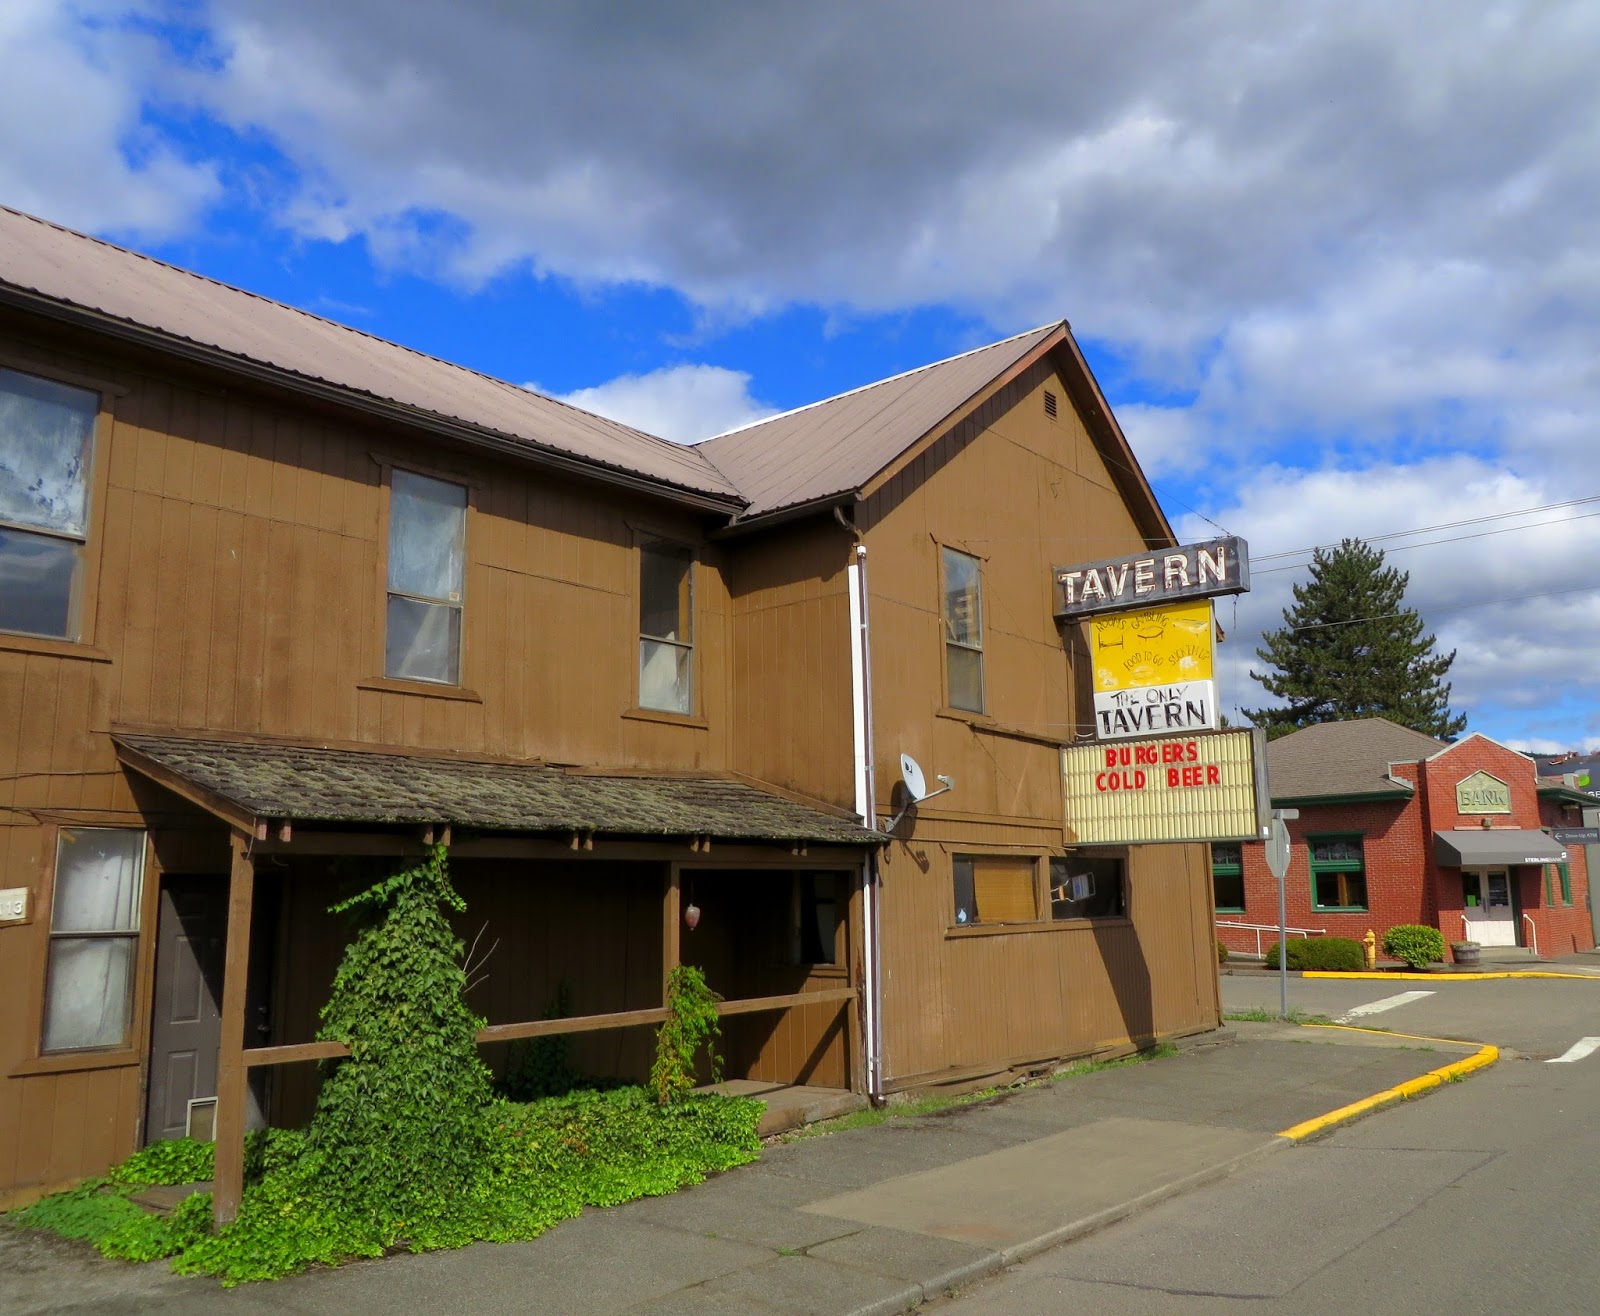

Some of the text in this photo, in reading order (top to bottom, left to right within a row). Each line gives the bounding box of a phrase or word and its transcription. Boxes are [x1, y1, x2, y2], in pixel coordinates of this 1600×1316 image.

[1058, 546, 1226, 604] TAVERN
[1095, 616, 1127, 632] ROOMS
[1131, 610, 1169, 630] GAMBLING
[1123, 650, 1164, 671] FOOD TO GO
[1111, 685, 1189, 707] THE ONLY
[1097, 699, 1206, 735] TAVERN
[1106, 742, 1197, 767] BURGERS
[1096, 765, 1219, 791] COLD BEER
[1459, 790, 1507, 805] BANK
